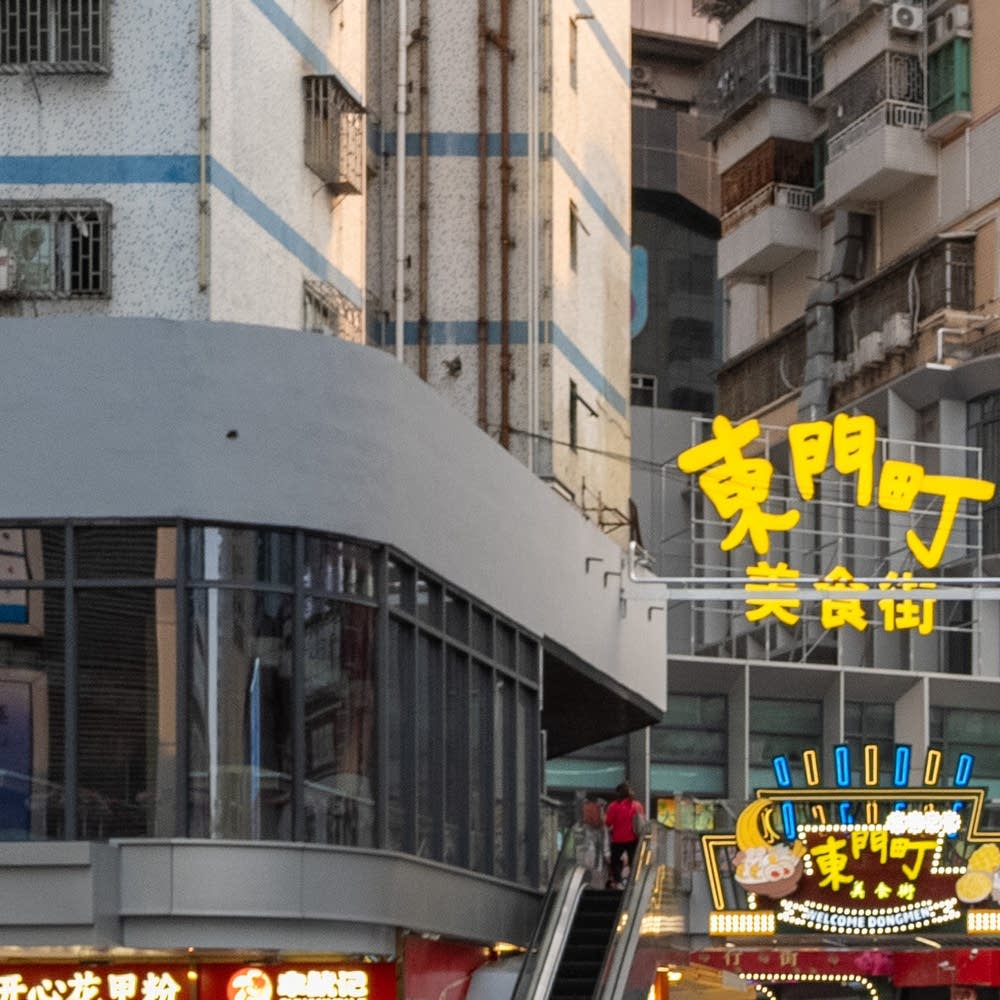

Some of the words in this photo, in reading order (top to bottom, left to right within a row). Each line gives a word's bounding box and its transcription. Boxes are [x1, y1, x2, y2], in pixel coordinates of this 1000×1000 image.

[677, 413, 996, 569] 東門町
[744, 561, 937, 635] 美食街
[809, 830, 939, 891] 東門町
[807, 909, 866, 929] WELCOME
[867, 906, 931, 929] DONGMEN
